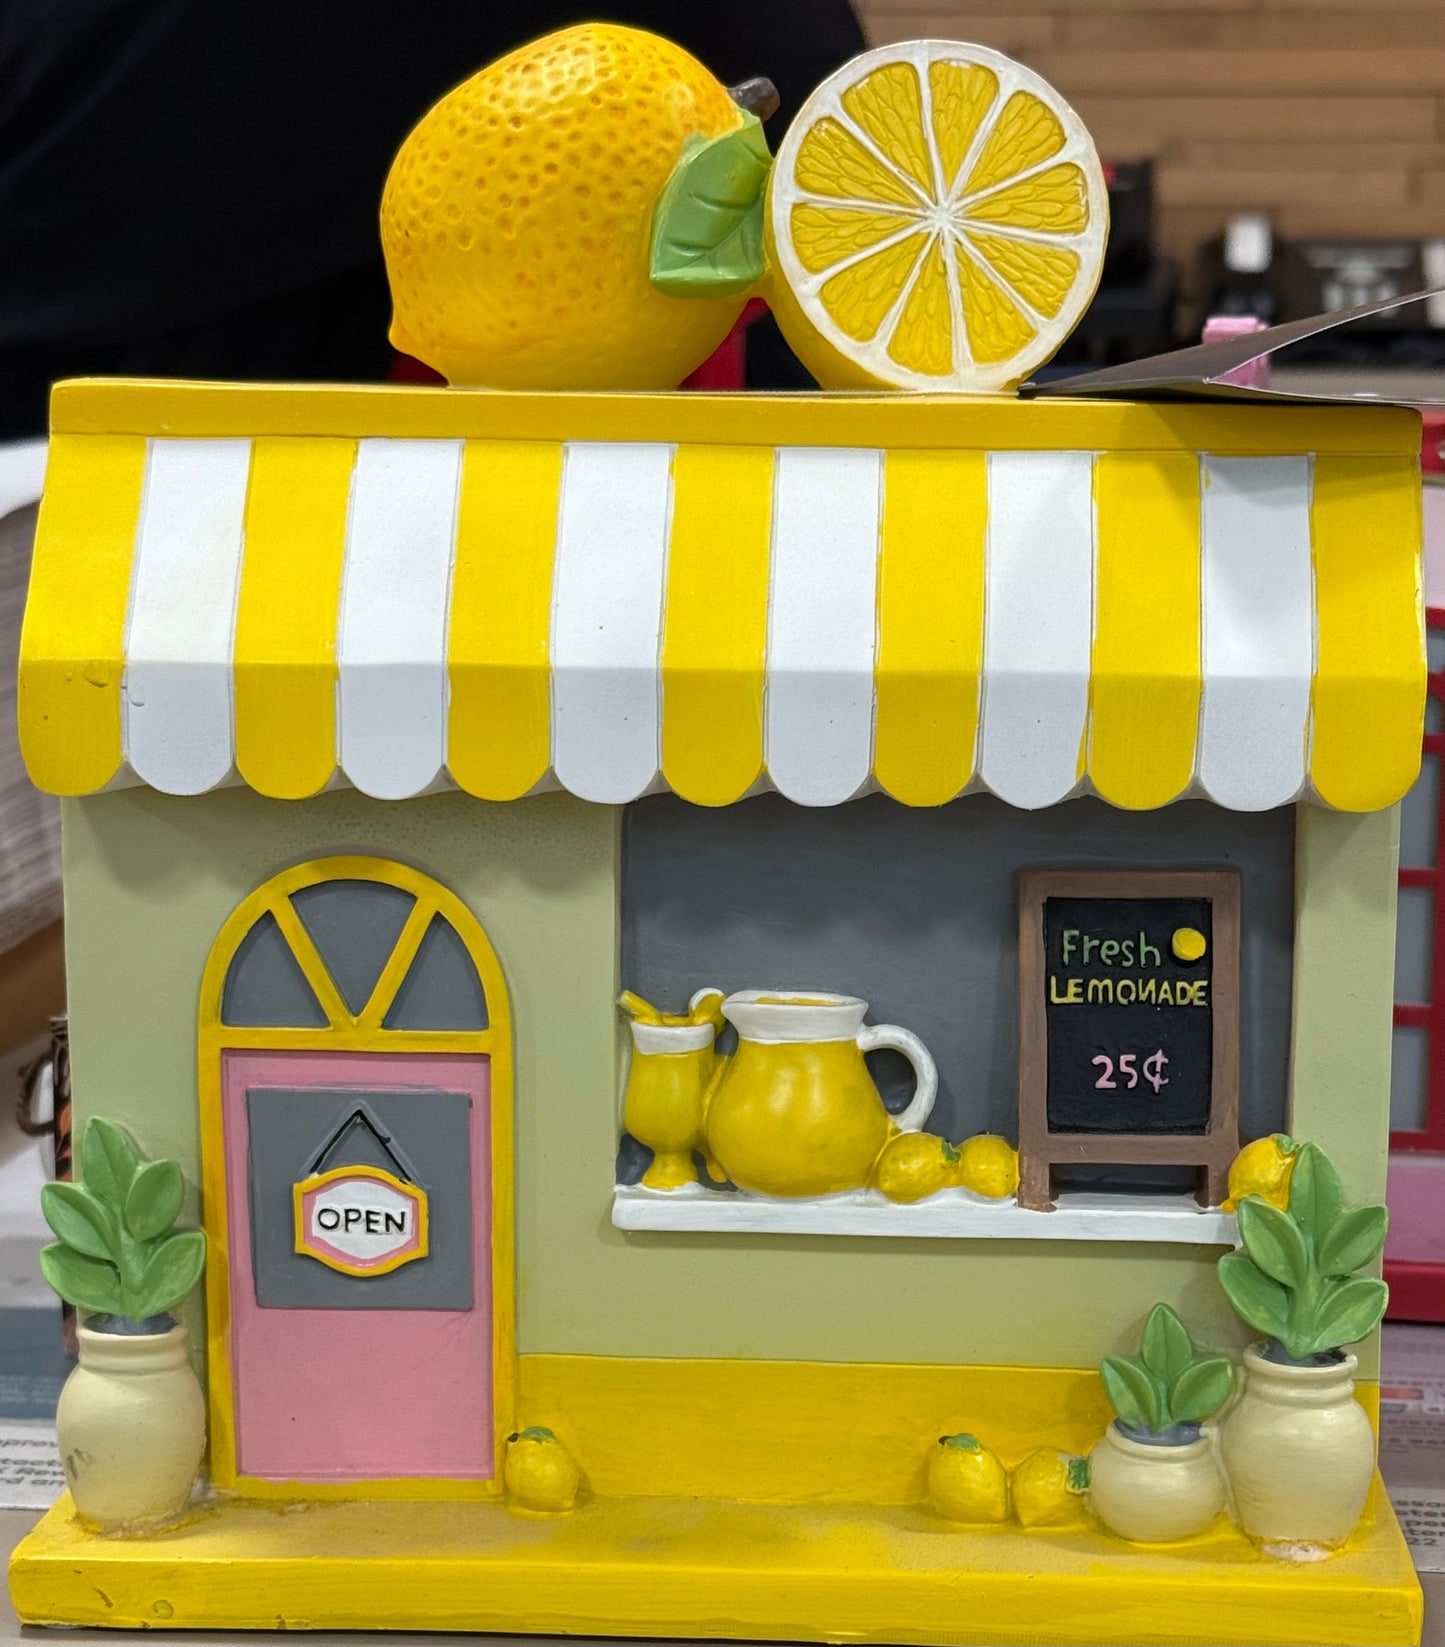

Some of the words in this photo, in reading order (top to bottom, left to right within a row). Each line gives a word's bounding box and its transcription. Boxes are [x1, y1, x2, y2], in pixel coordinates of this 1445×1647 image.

[1062, 929, 1162, 968] Fresh
[1050, 975, 1208, 1006] LEMONADE
[317, 1208, 406, 1233] OPEN
